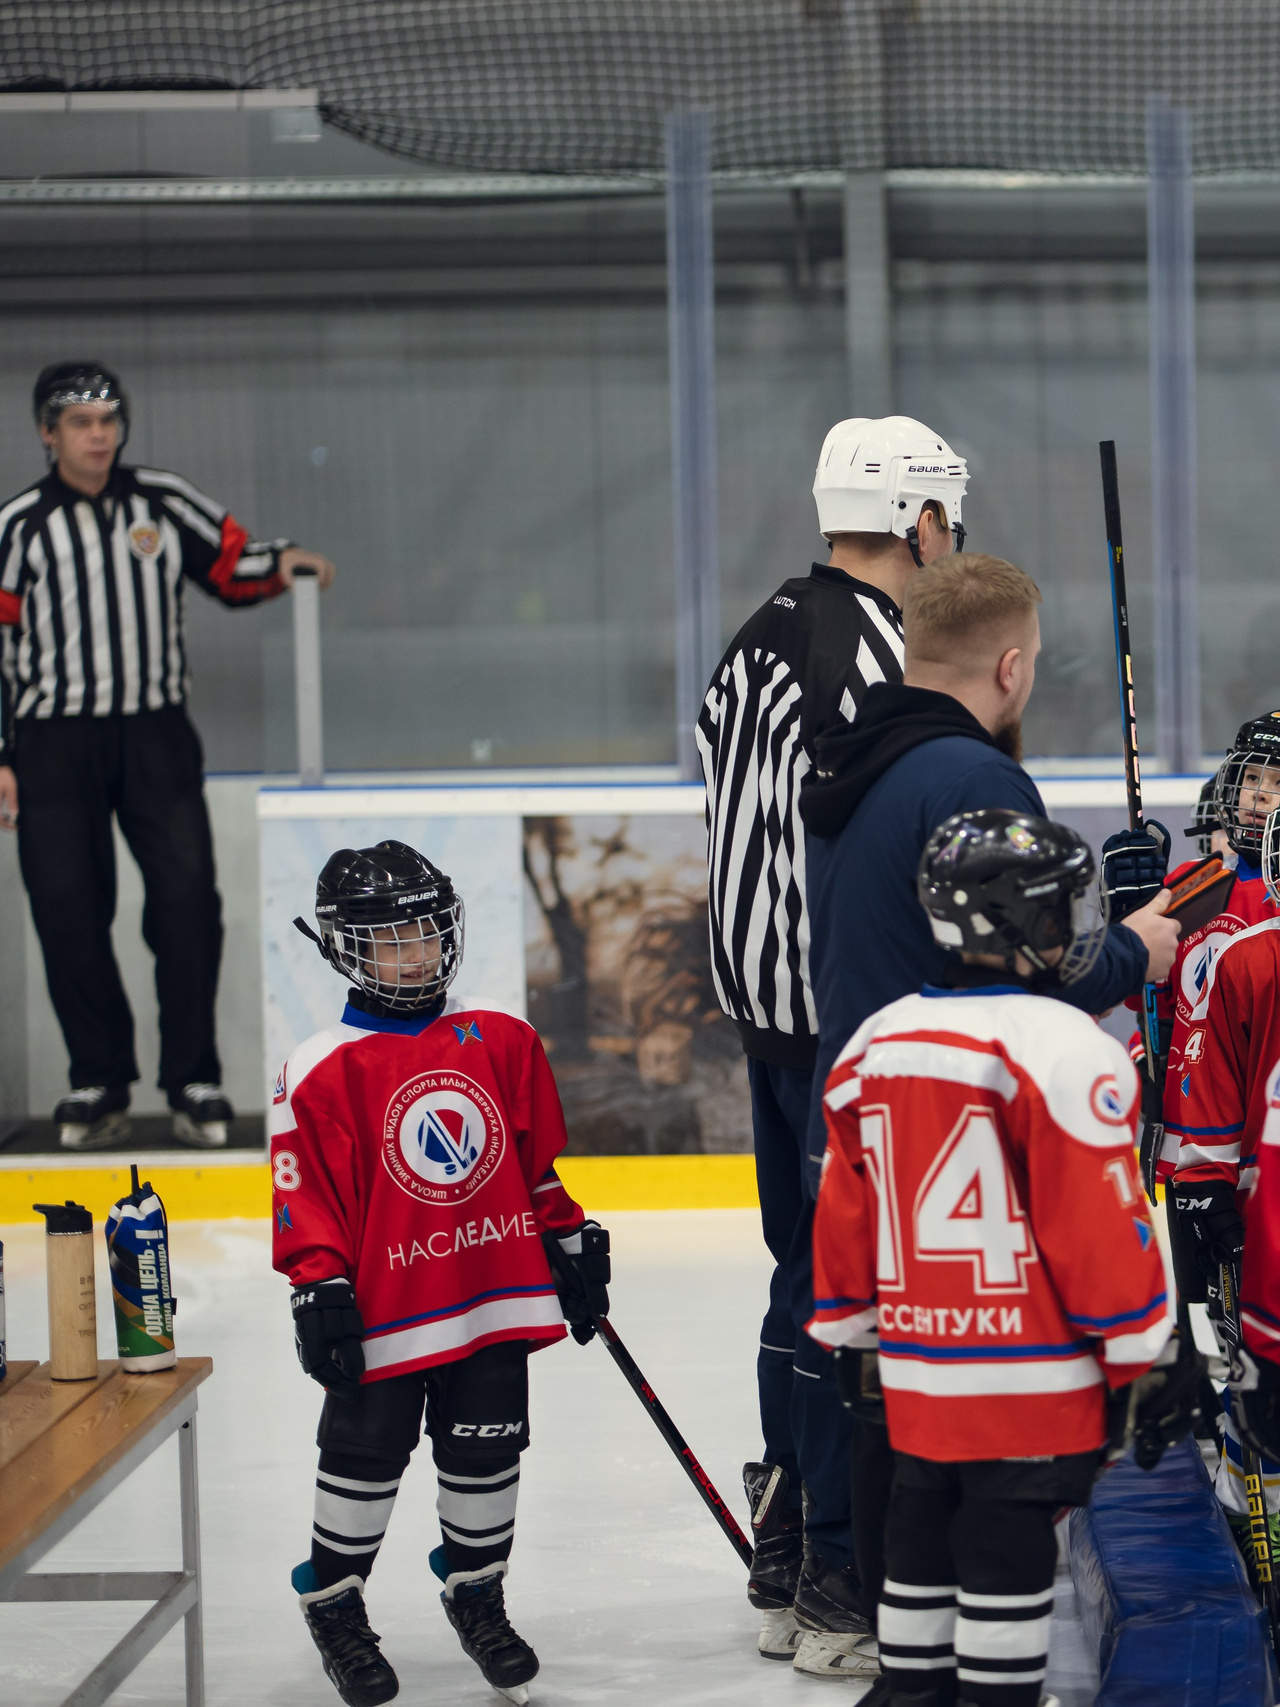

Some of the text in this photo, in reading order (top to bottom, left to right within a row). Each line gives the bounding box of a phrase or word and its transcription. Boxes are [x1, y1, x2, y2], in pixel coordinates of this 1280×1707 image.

[773, 595, 797, 610] LUTCH
[316, 904, 337, 913] BAUER
[398, 890, 439, 905] BAUER
[1182, 931, 1203, 952] ИДОВ
[1203, 920, 1228, 934] СПОРТА
[1184, 1028, 1206, 1064] 4
[401, 1079, 438, 1103] СПОРТА
[440, 1077, 468, 1090] ИЛЬИ
[386, 1103, 404, 1139] ВИДОВ
[468, 1088, 499, 1133] АВЕРБУХА
[386, 1142, 411, 1183] ЗИМНИХ
[410, 1180, 447, 1199] ШКОЛА
[858, 1104, 1039, 1295] 14
[1176, 1197, 1213, 1210] CM
[387, 1211, 537, 1270] НАСЛЕДИЕ
[138, 1249, 159, 1290] ЦЕЛЬ
[142, 1294, 164, 1336] ОДНА
[878, 1303, 1022, 1336] ССЕНТУКИ
[451, 1421, 523, 1438] CCM
[682, 1448, 748, 1547] FISCHER
[1244, 1473, 1272, 1583] BAUER
